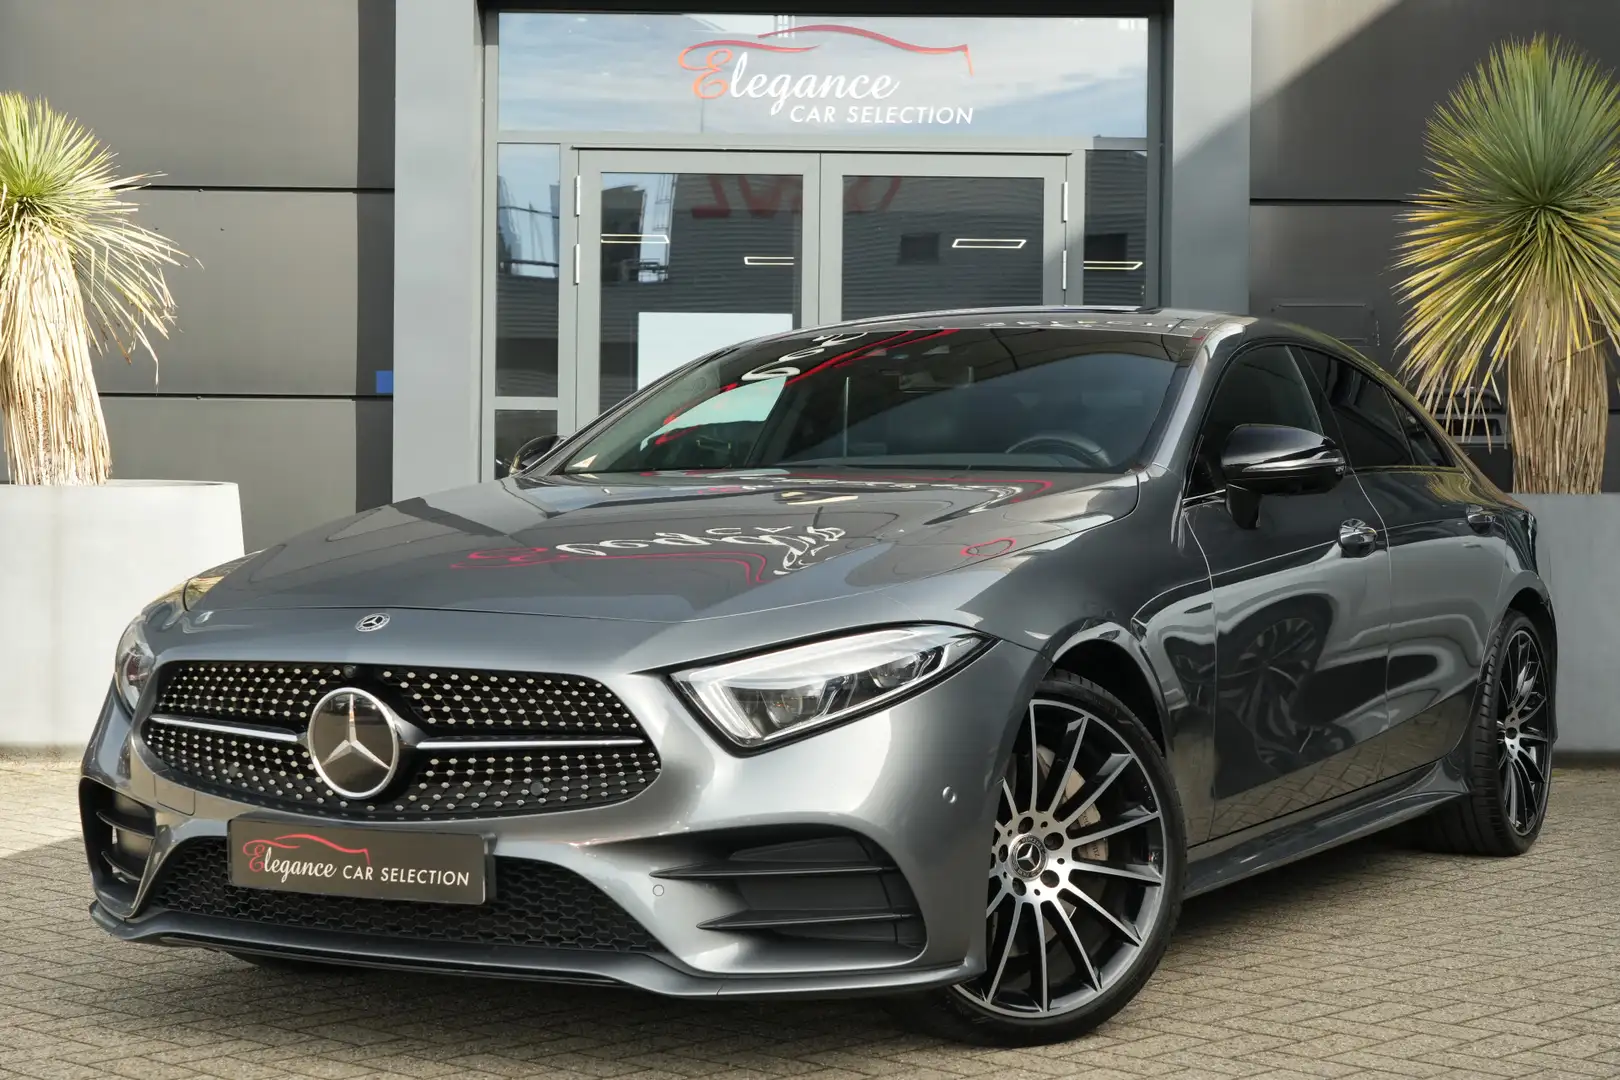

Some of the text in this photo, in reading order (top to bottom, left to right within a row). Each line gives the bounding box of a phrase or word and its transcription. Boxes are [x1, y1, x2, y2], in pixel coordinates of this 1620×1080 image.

[678, 47, 901, 117] Elegance
[790, 106, 974, 125] CAR SELECTION
[243, 841, 470, 887] Elegance CAR SELECTION
